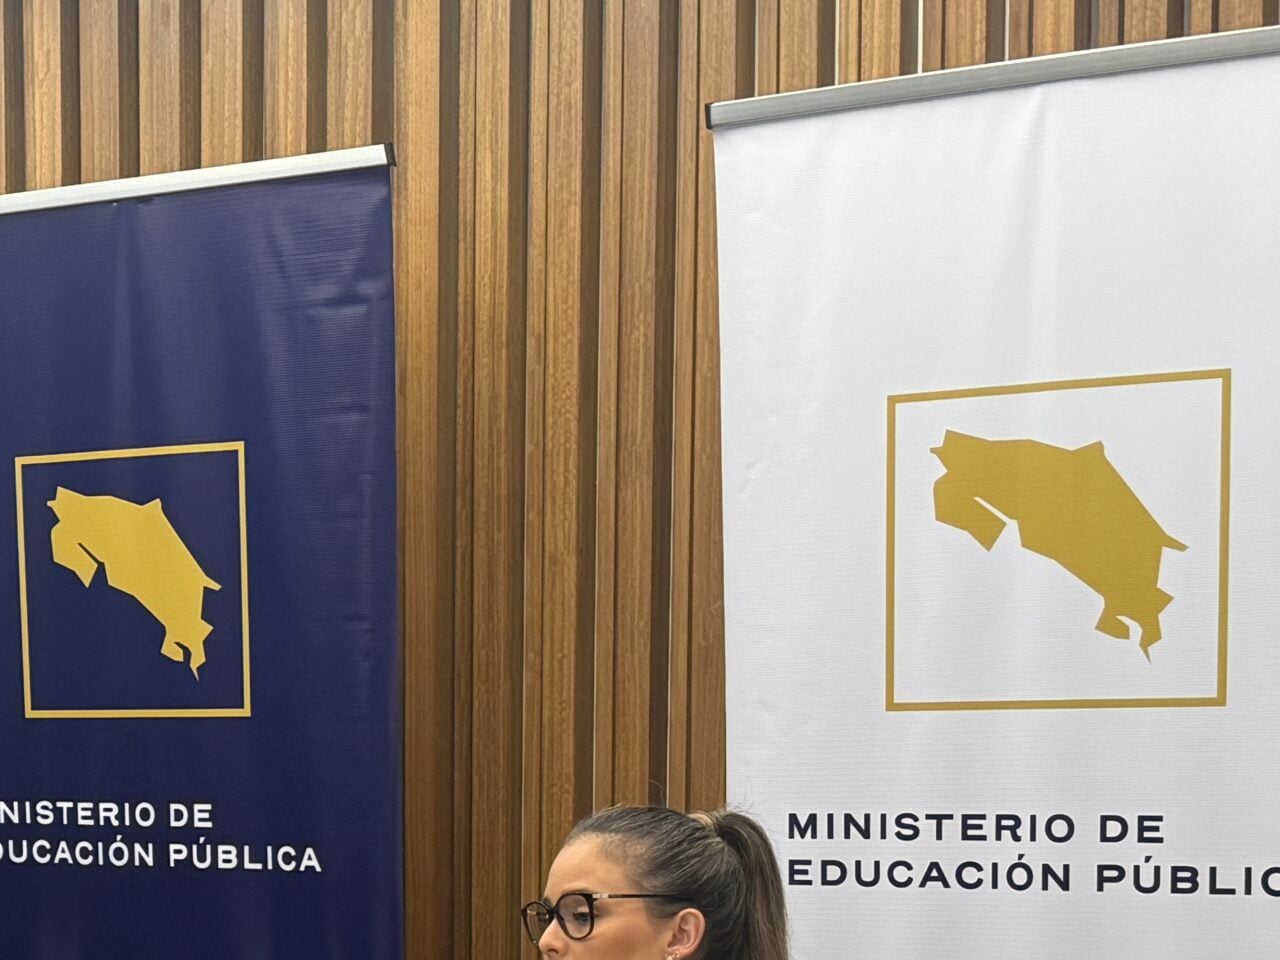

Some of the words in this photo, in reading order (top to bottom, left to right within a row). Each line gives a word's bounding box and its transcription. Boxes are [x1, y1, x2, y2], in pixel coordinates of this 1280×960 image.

[168, 802, 213, 828] DE
[787, 813, 1076, 844] MINISTERIO
[1099, 814, 1165, 844] DE
[168, 837, 322, 873] PÚBLICA
[788, 853, 1071, 892] EDUCACIÓN
